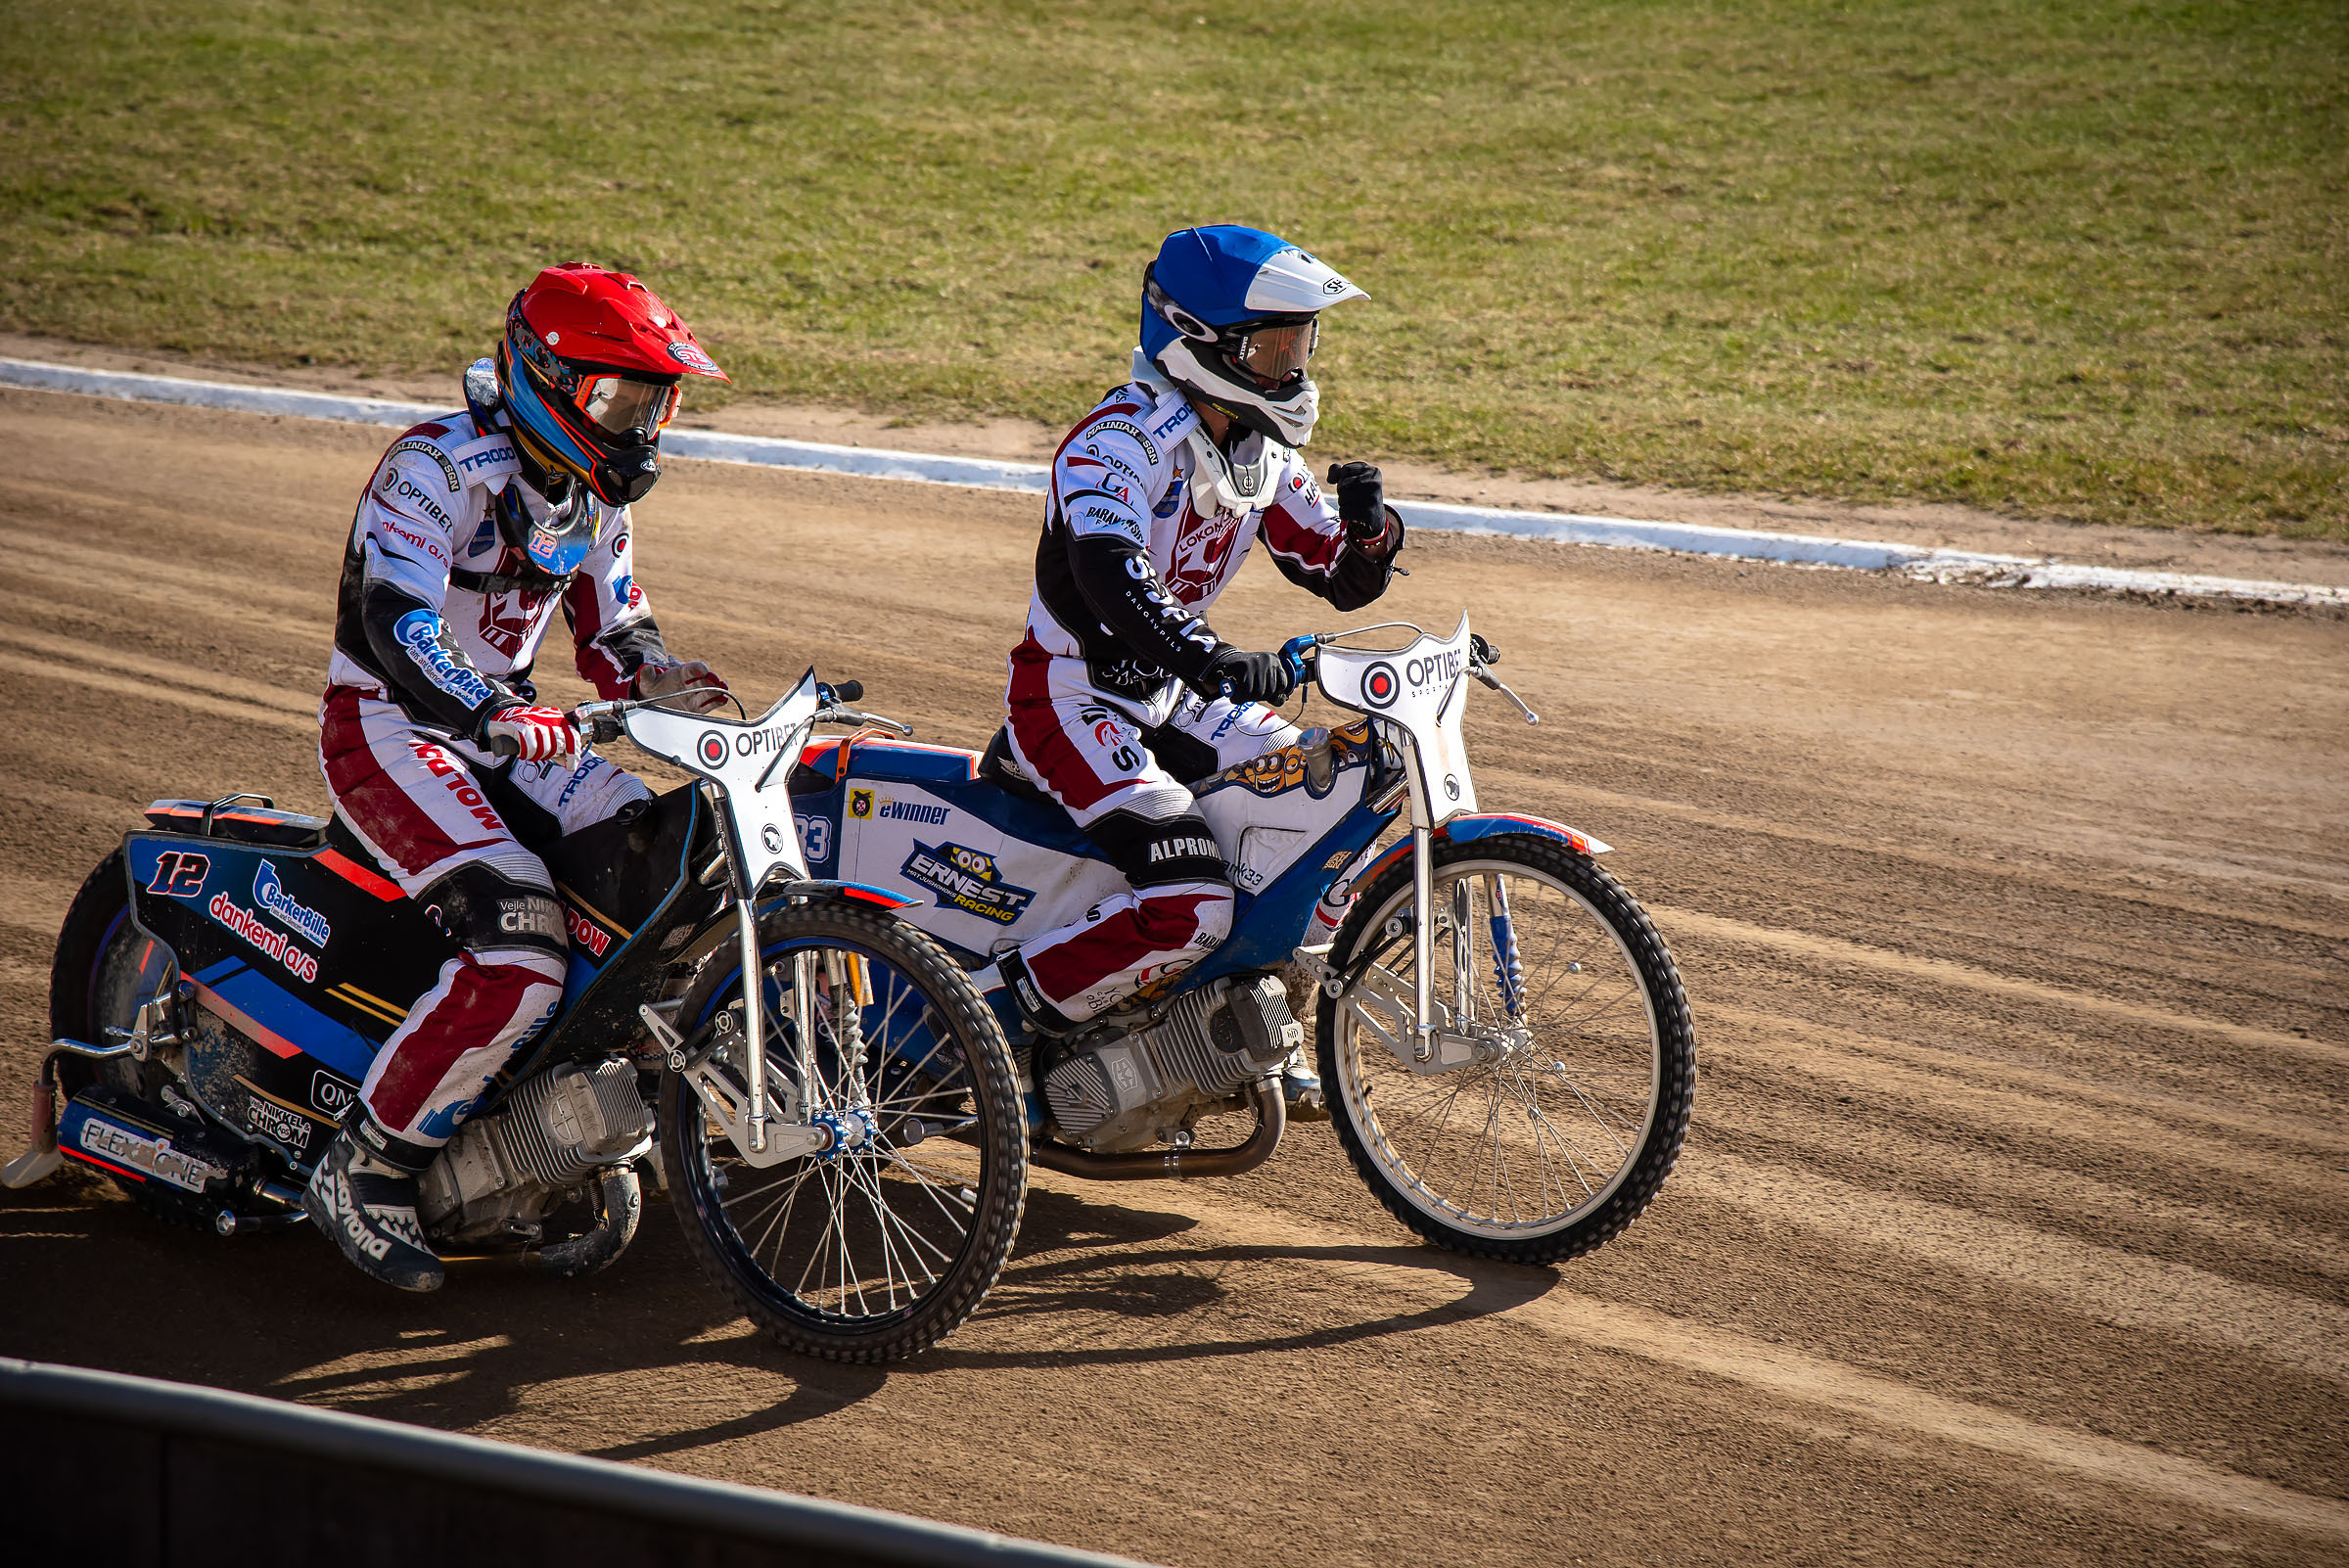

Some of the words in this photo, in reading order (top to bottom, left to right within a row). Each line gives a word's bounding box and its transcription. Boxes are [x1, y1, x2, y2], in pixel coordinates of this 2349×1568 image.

[458, 446, 517, 472] TRODO
[1142, 439, 1159, 465] SGN
[444, 464, 459, 491] SGN
[1126, 591, 1181, 653] DAUGAVPILS
[409, 624, 492, 702] BarkerBile
[558, 757, 608, 807] TRODO
[147, 851, 210, 898] 12
[910, 853, 1026, 906] ERNEST
[265, 884, 331, 941] BarkerBille
[500, 899, 526, 911] Vejle
[954, 894, 1016, 922] RACING
[209, 892, 287, 959] dankemi
[284, 947, 316, 982] a/s
[563, 904, 612, 957] DOW
[248, 1105, 311, 1149] CHROM
[263, 1101, 305, 1128] NIKKEL
[303, 1122, 312, 1132] &
[337, 1168, 393, 1261] daytona
